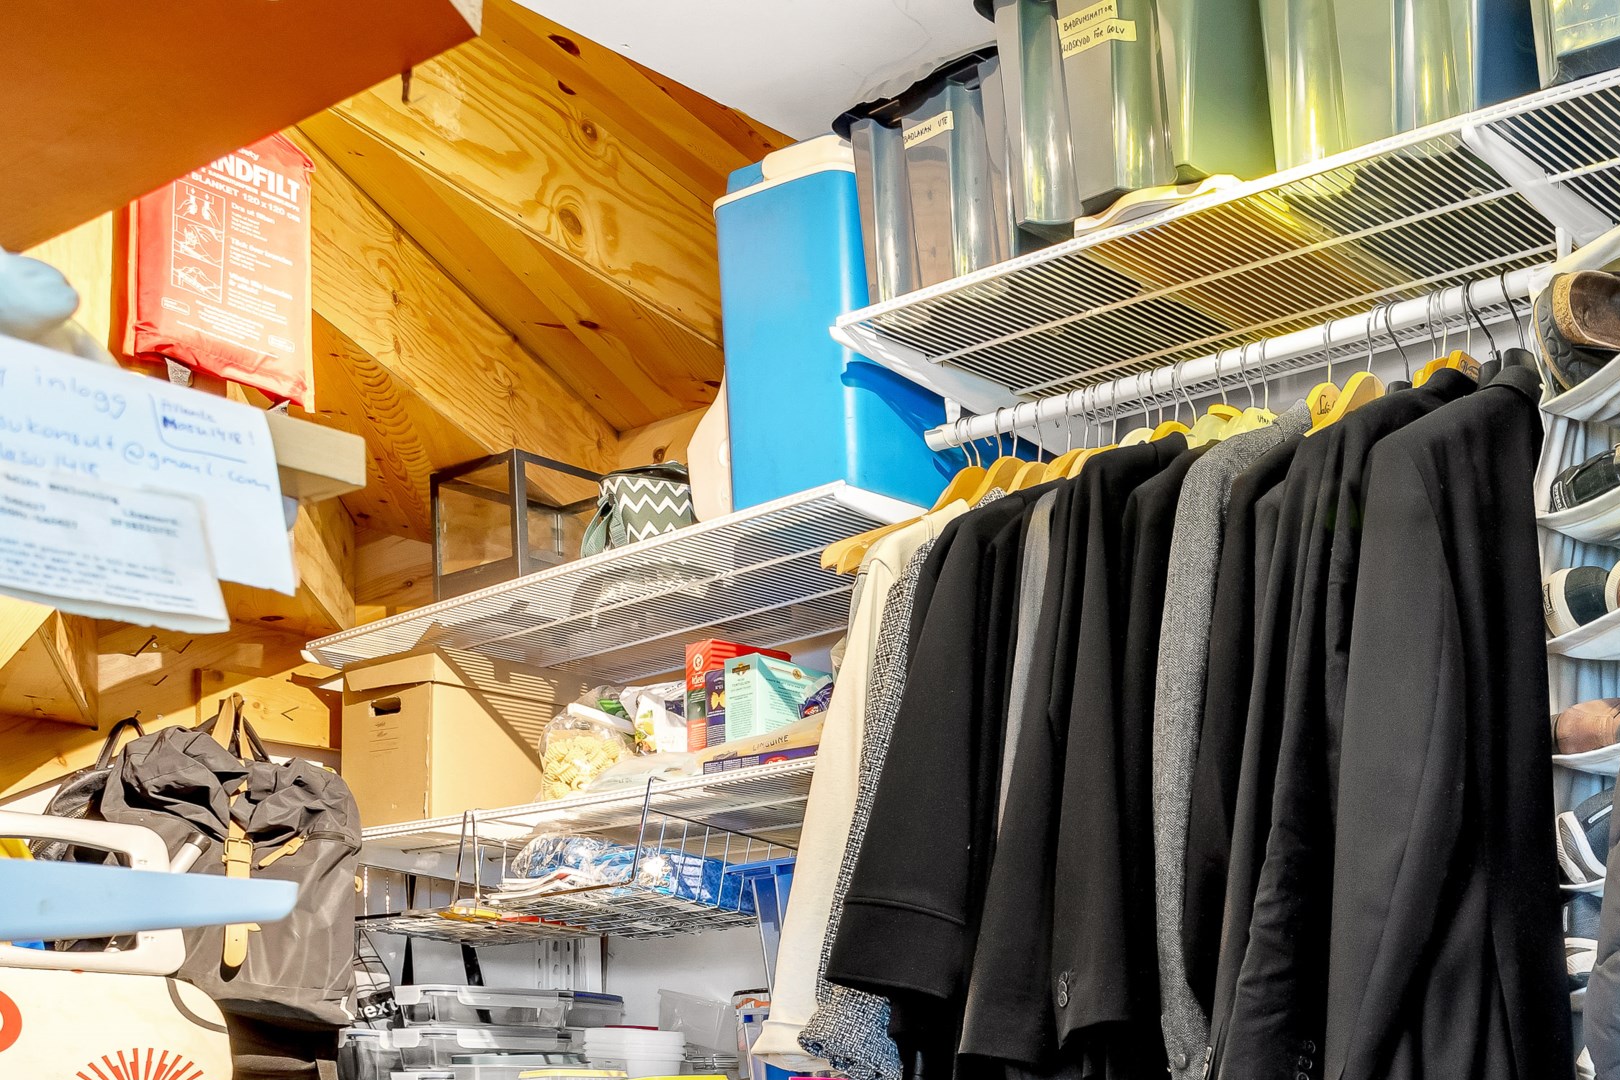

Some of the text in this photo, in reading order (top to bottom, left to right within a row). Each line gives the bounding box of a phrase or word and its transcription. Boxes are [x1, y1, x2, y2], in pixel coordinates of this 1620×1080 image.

[1063, 4, 1113, 32] BADRUMSMATTOR
[1093, 27, 1104, 38] FÖR
[1106, 24, 1125, 34] GOLV
[191, 171, 239, 197] BLANKET
[242, 192, 261, 206] 120
[267, 202, 285, 216] 120
